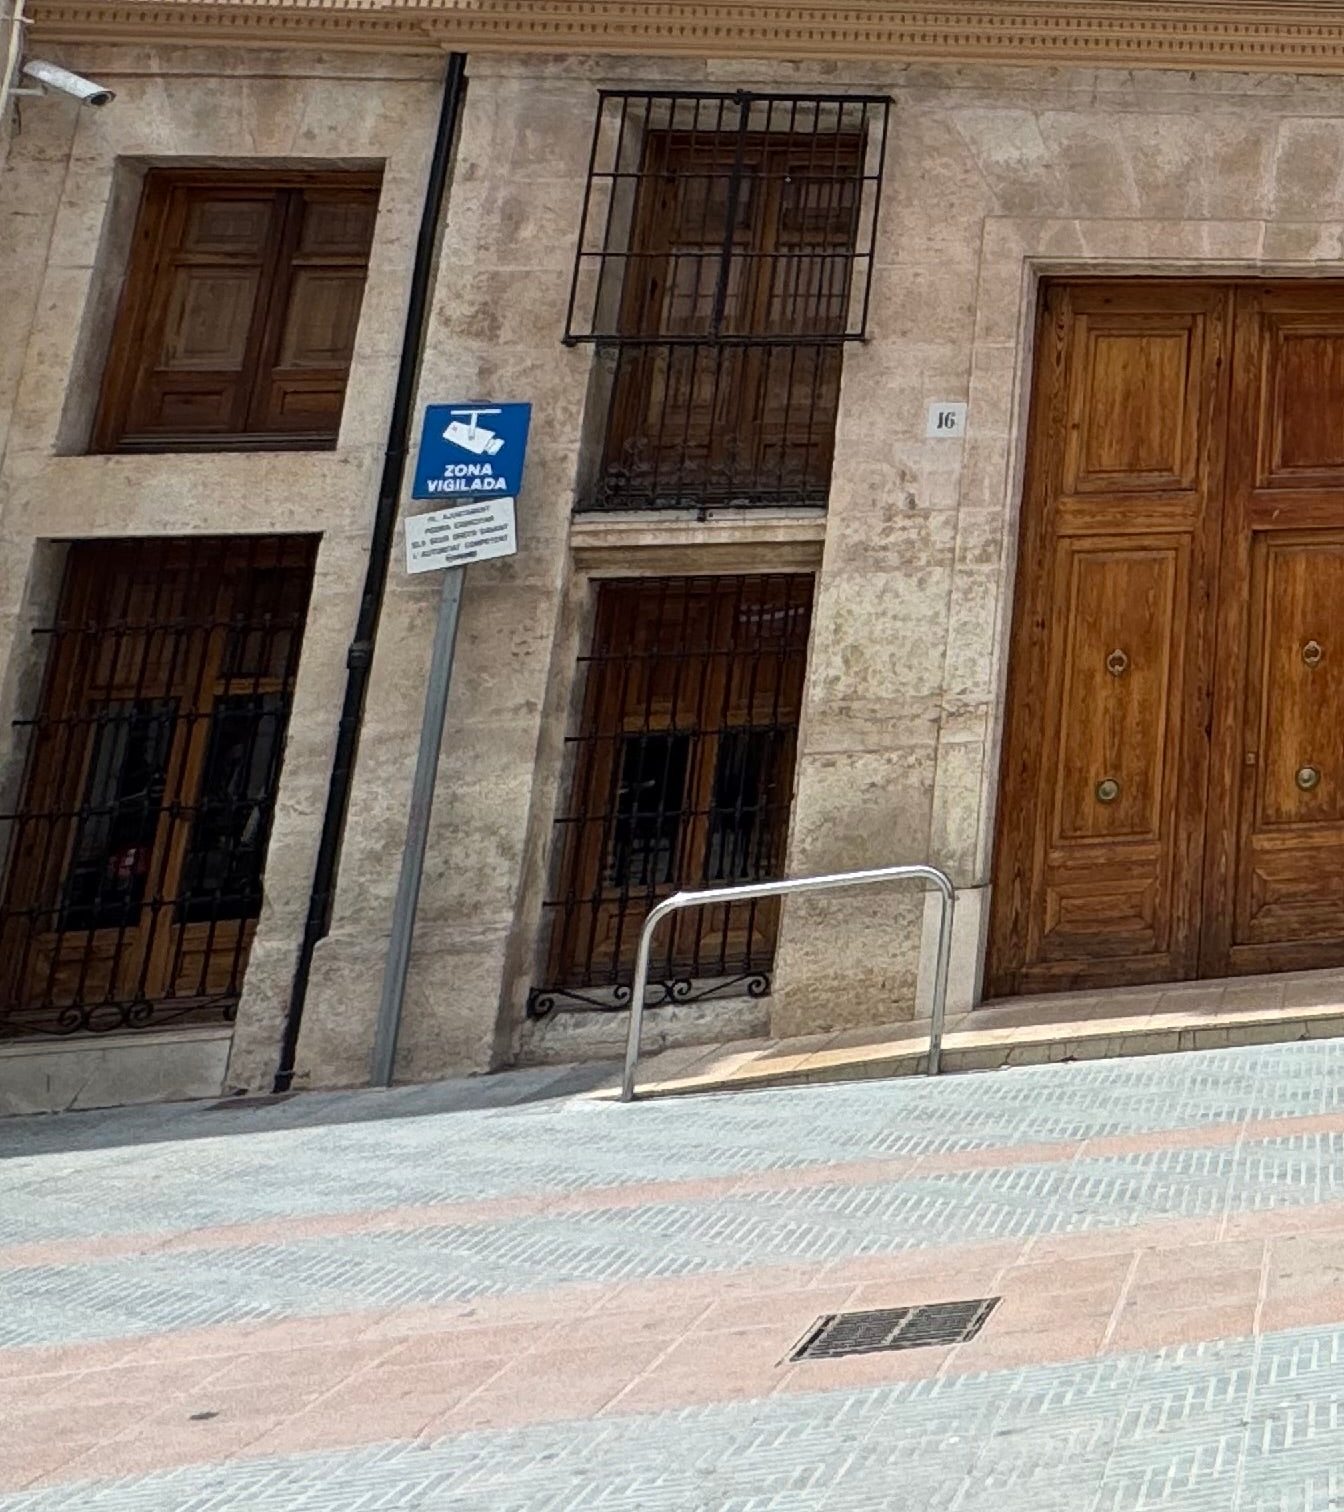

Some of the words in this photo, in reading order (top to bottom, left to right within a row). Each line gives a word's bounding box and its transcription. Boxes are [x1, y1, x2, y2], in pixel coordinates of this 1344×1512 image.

[936, 411, 956, 429] 16
[444, 463, 493, 477] ZONA
[427, 477, 507, 492] VIGILADA
